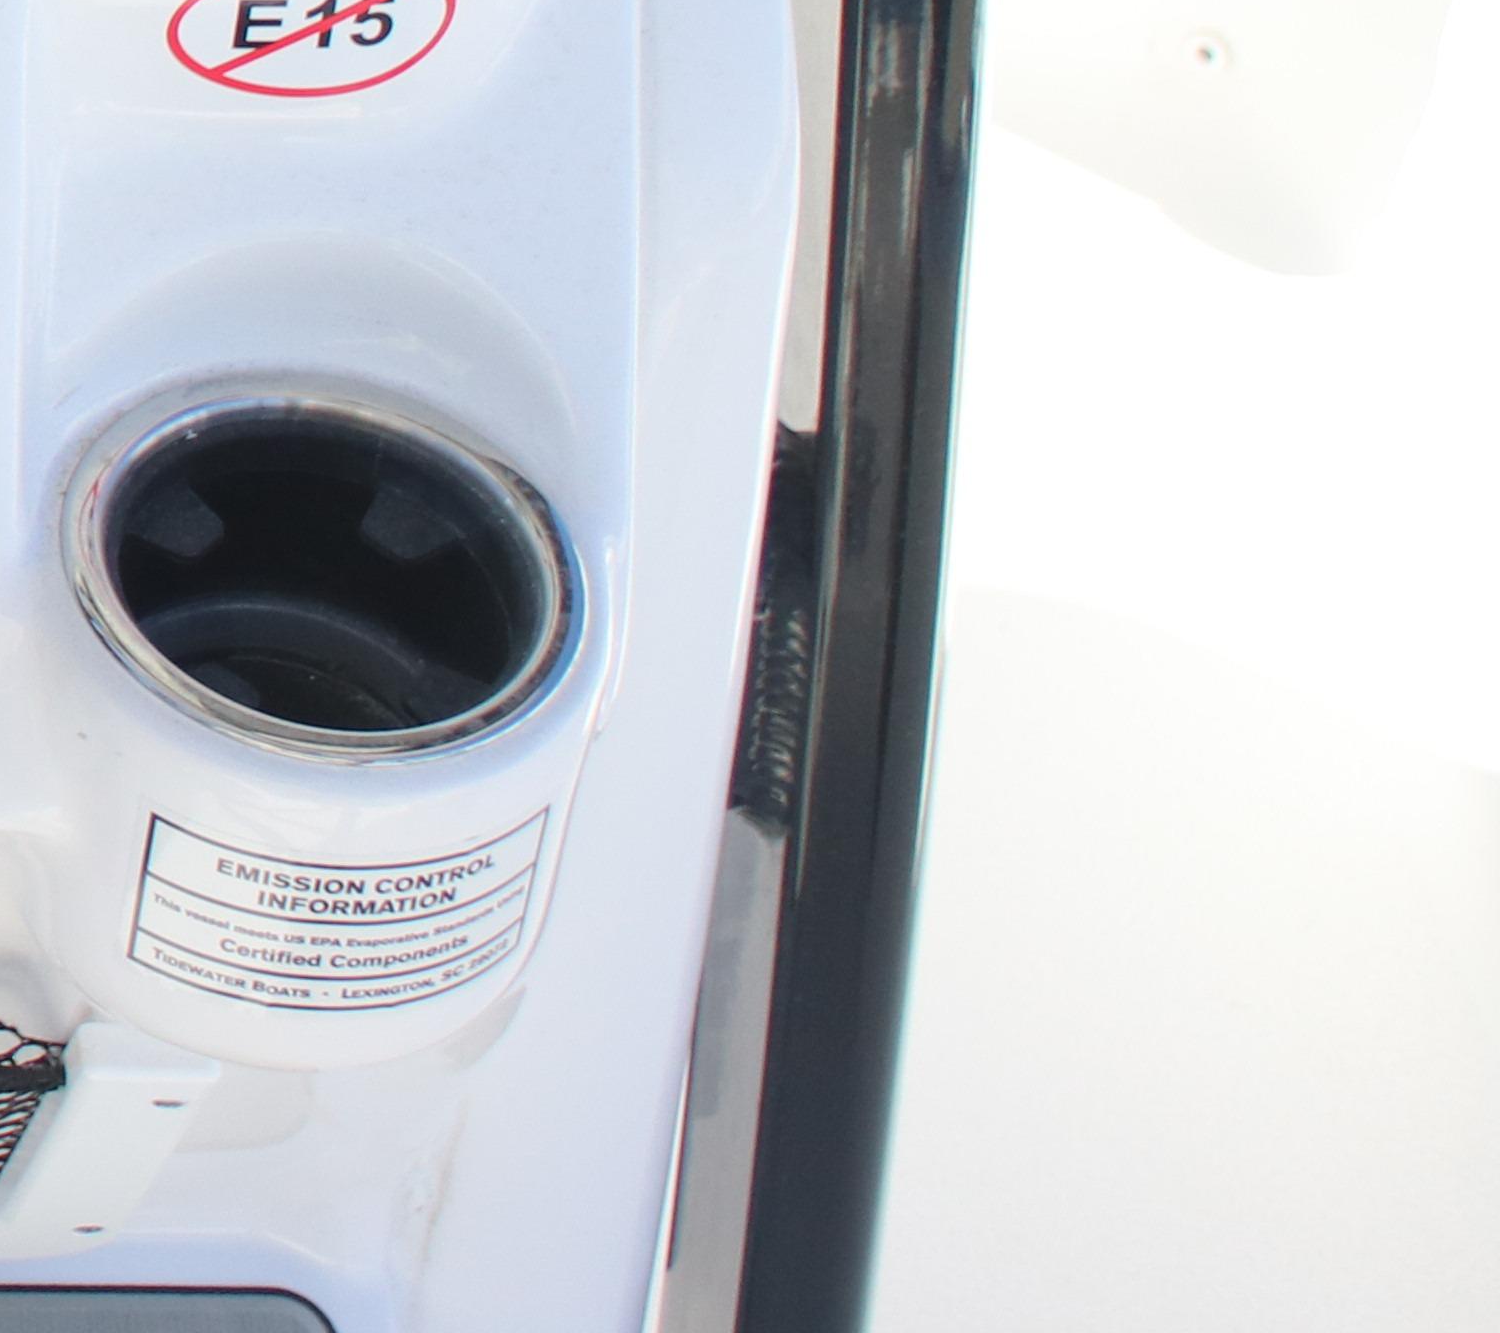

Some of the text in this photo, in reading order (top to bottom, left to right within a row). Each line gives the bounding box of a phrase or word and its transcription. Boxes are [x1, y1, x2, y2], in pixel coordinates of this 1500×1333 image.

[215, 854, 495, 894] EMISSION CONTROL
[256, 888, 457, 916] INFORMATION
[219, 935, 468, 968] Certified Components
[284, 934, 305, 944] US
[310, 936, 341, 947] EPA
[152, 946, 245, 988] TIDEWATER
[251, 980, 311, 998] BOATS
